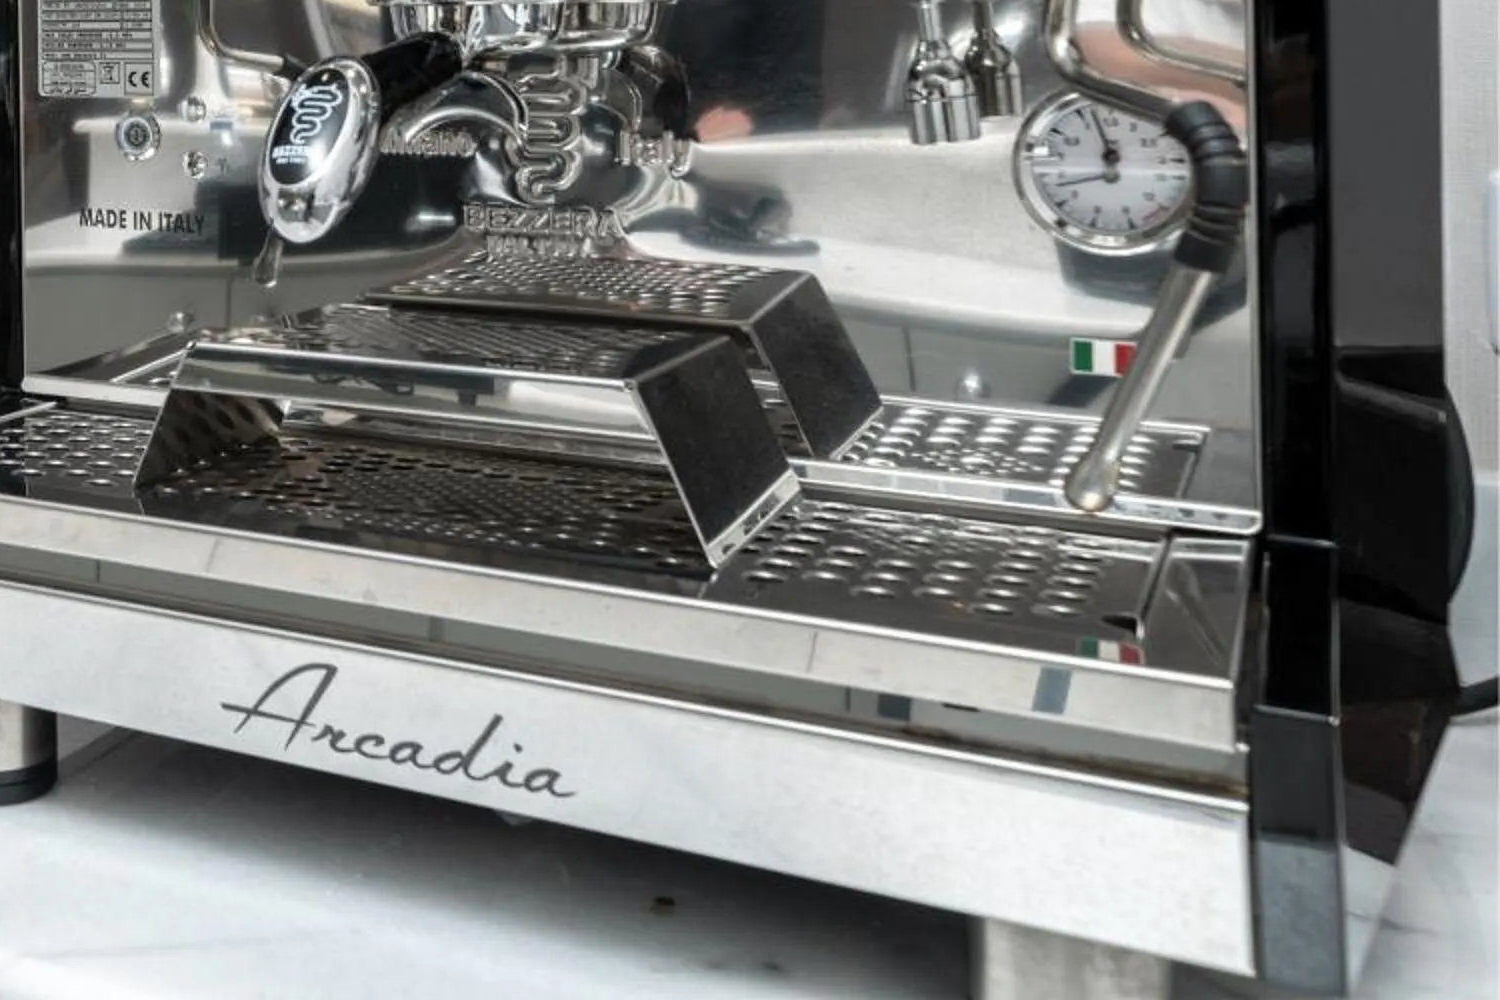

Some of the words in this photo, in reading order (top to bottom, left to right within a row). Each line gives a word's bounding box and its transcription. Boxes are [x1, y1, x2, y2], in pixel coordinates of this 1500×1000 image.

[80, 208, 127, 229] MADE
[133, 211, 152, 231] IN
[158, 212, 205, 236] ITALY
[464, 203, 626, 238] BEZZERA
[220, 663, 576, 798] Arcadia
